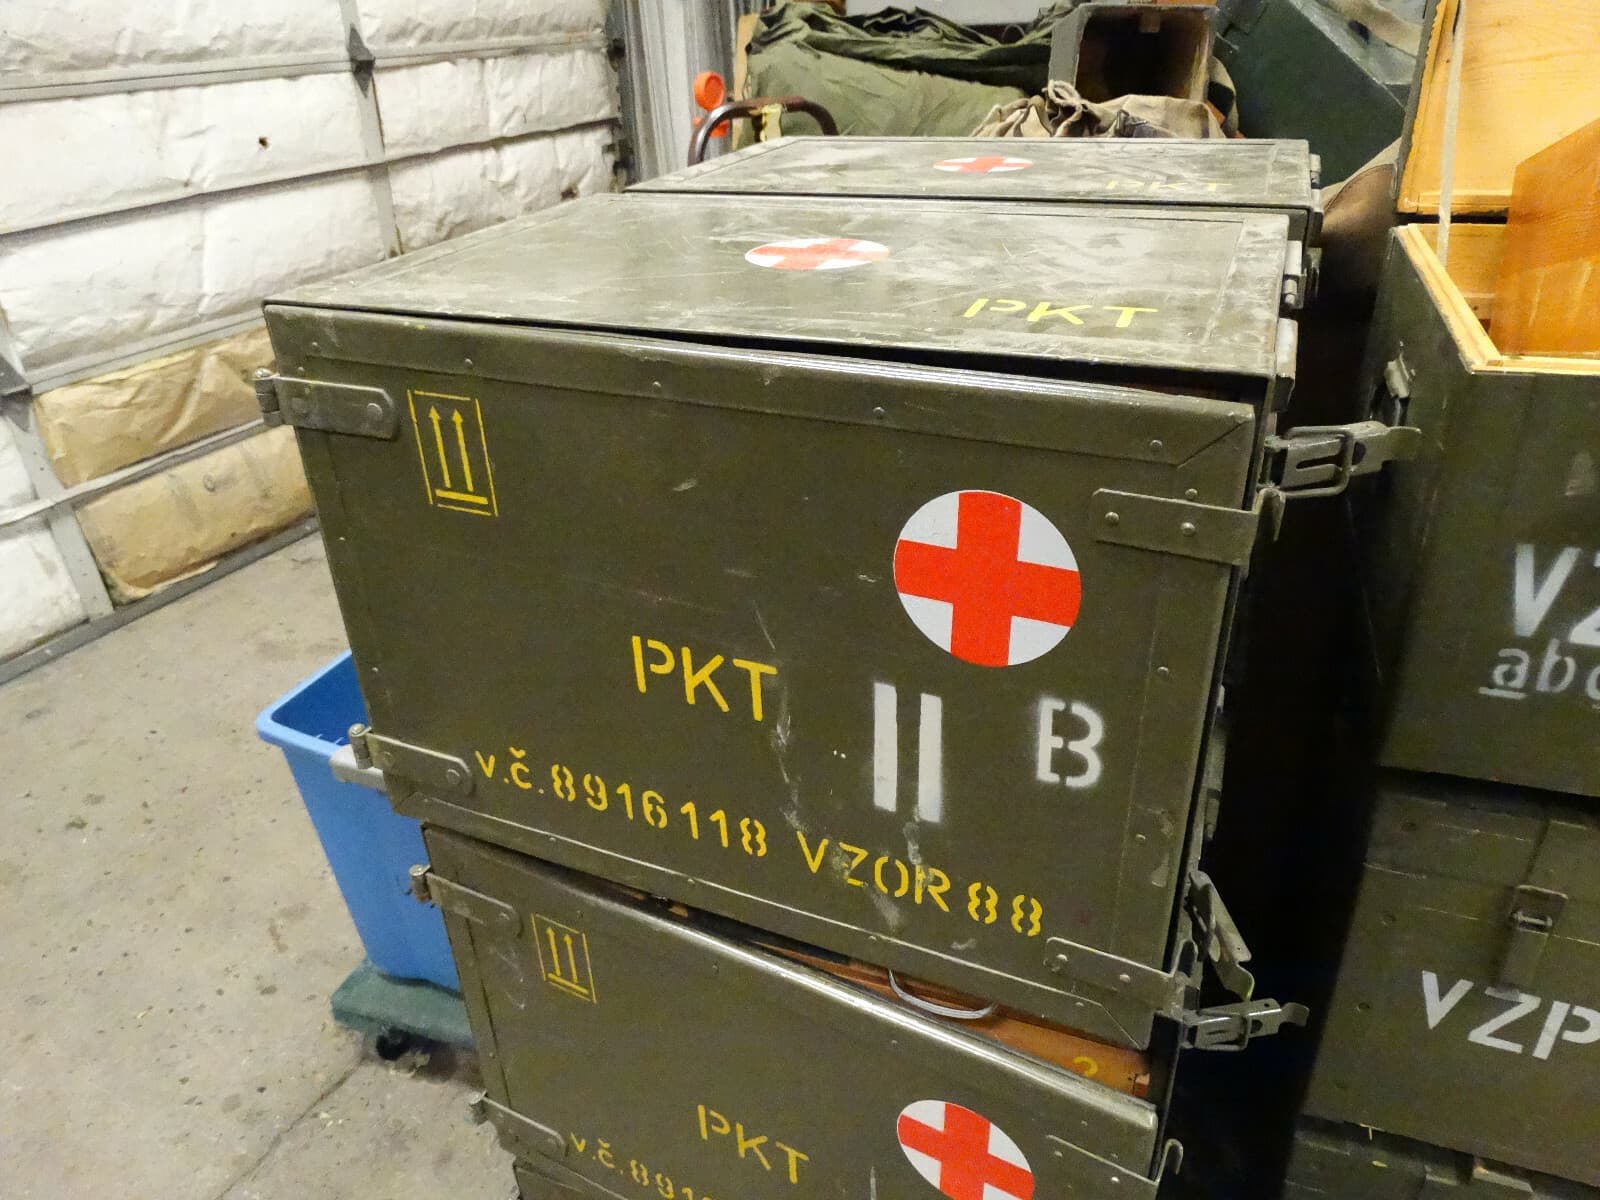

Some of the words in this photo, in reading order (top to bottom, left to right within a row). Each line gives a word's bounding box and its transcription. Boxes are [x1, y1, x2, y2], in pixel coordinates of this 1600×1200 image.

[1106, 180, 1232, 192] PKT
[963, 298, 1159, 328] PKT
[631, 635, 778, 722] PKT
[1037, 697, 1105, 789] B
[697, 1104, 809, 1184] PKT
